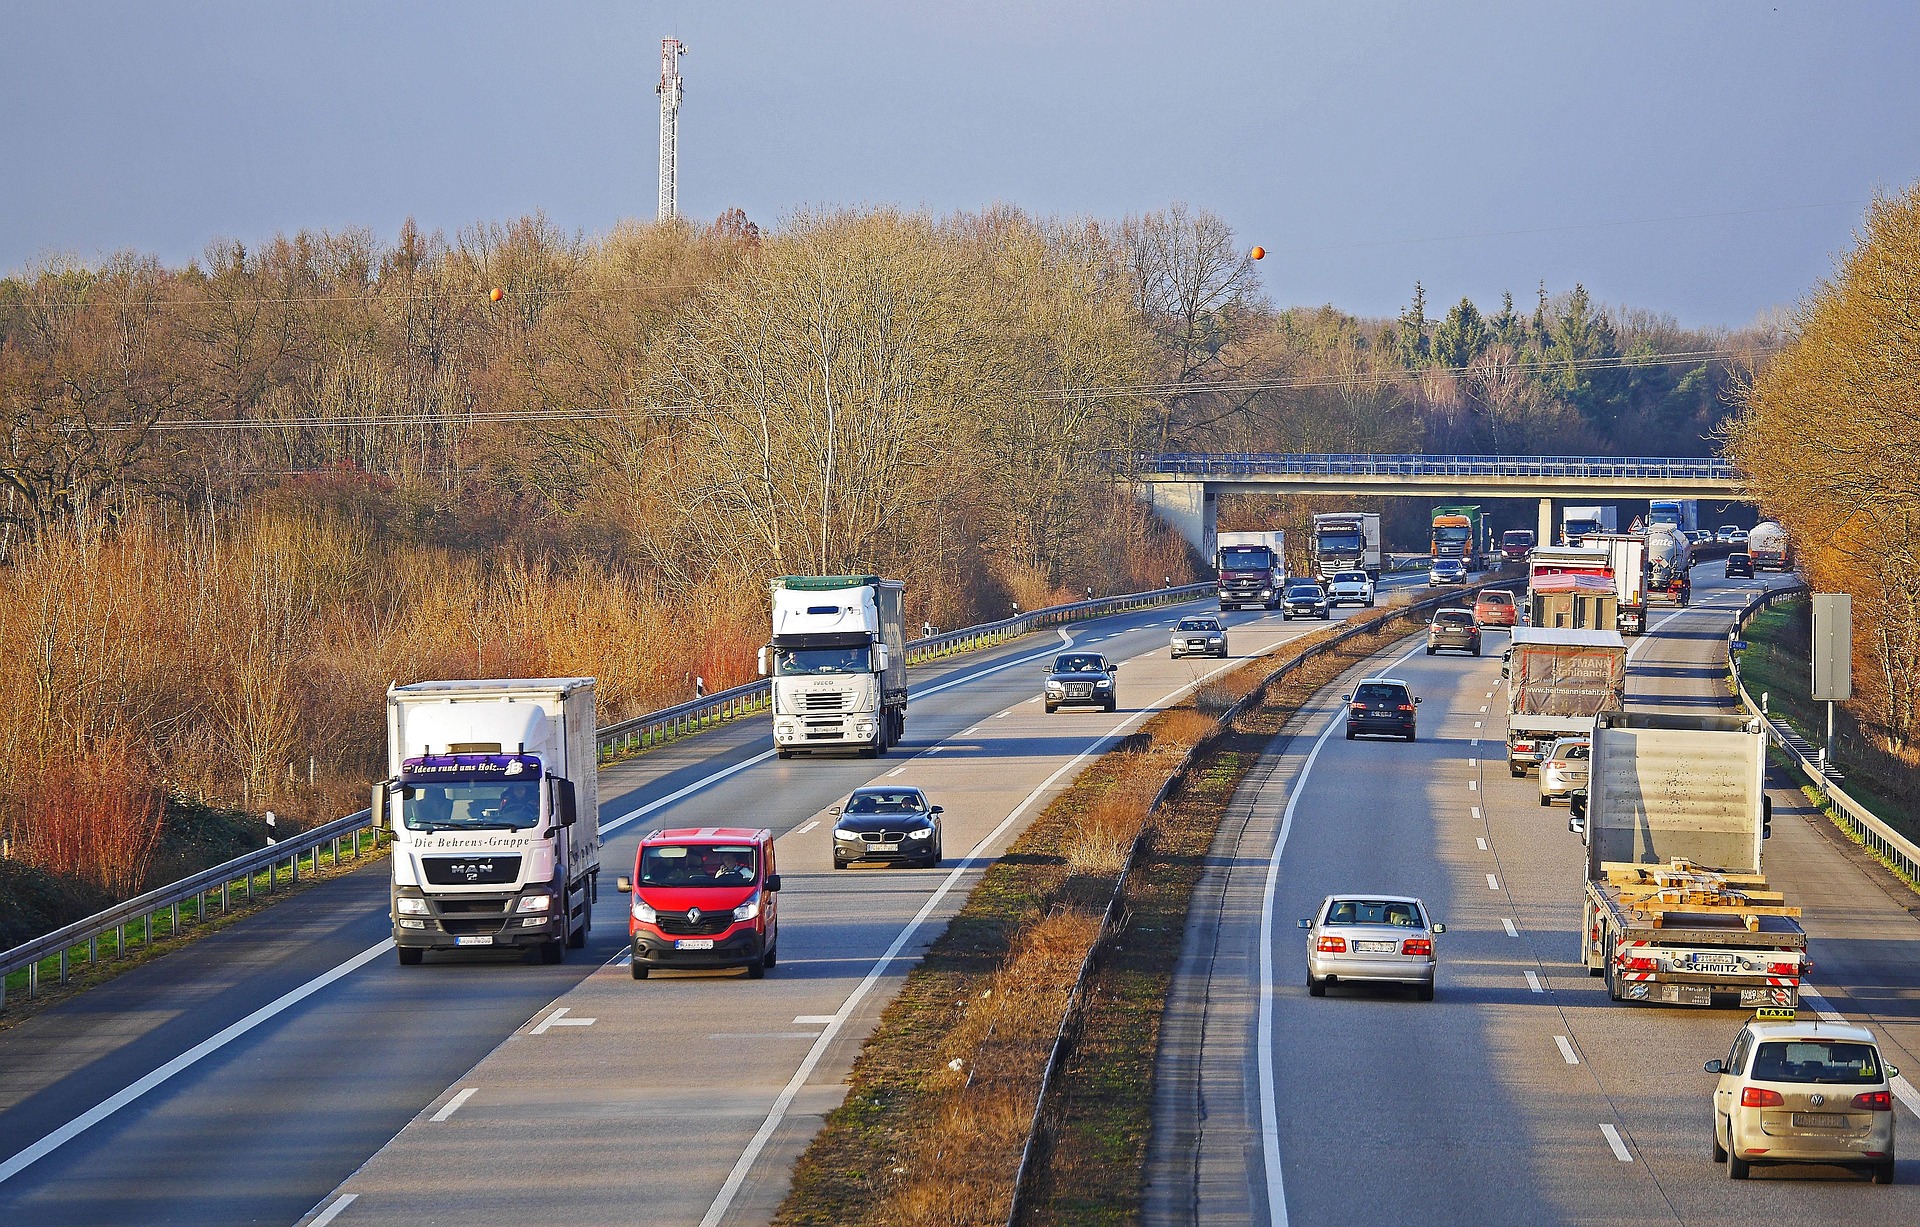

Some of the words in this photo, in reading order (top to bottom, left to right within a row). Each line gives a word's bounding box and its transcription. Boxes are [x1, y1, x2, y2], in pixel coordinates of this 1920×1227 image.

[413, 765, 437, 774] Ideen
[438, 764, 458, 772] rund
[459, 764, 476, 772] ums
[414, 838, 433, 848] Die
[438, 836, 530, 848] Behrens-Gruppe
[451, 864, 494, 874] MAN
[1686, 963, 1738, 973] SCHMITZ
